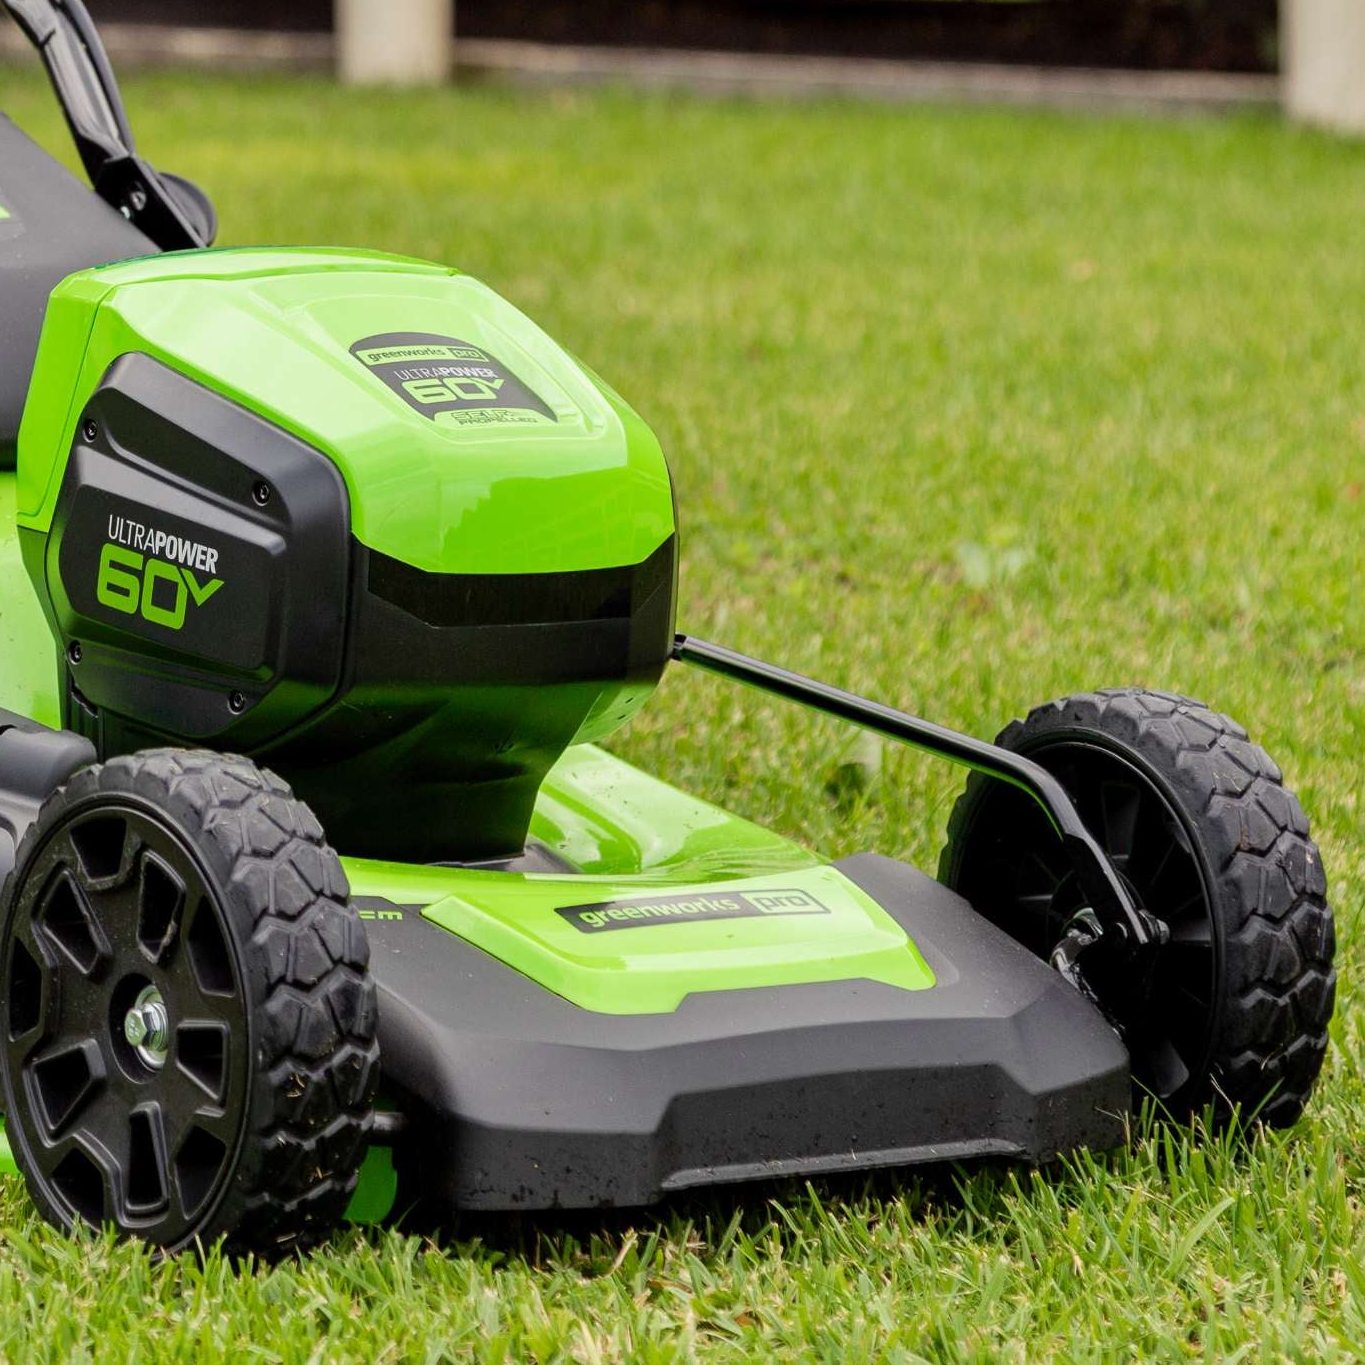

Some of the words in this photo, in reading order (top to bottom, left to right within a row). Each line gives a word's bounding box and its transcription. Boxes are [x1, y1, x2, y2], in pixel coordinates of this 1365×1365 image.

[368, 347, 446, 362] greenworks
[392, 365, 499, 382] ULTRAPOWER
[400, 377, 505, 405] 60V
[107, 513, 220, 575] ULTRAPOWER
[96, 542, 226, 631] 60V
[578, 897, 742, 928] greenworks
[750, 895, 813, 912] pro
